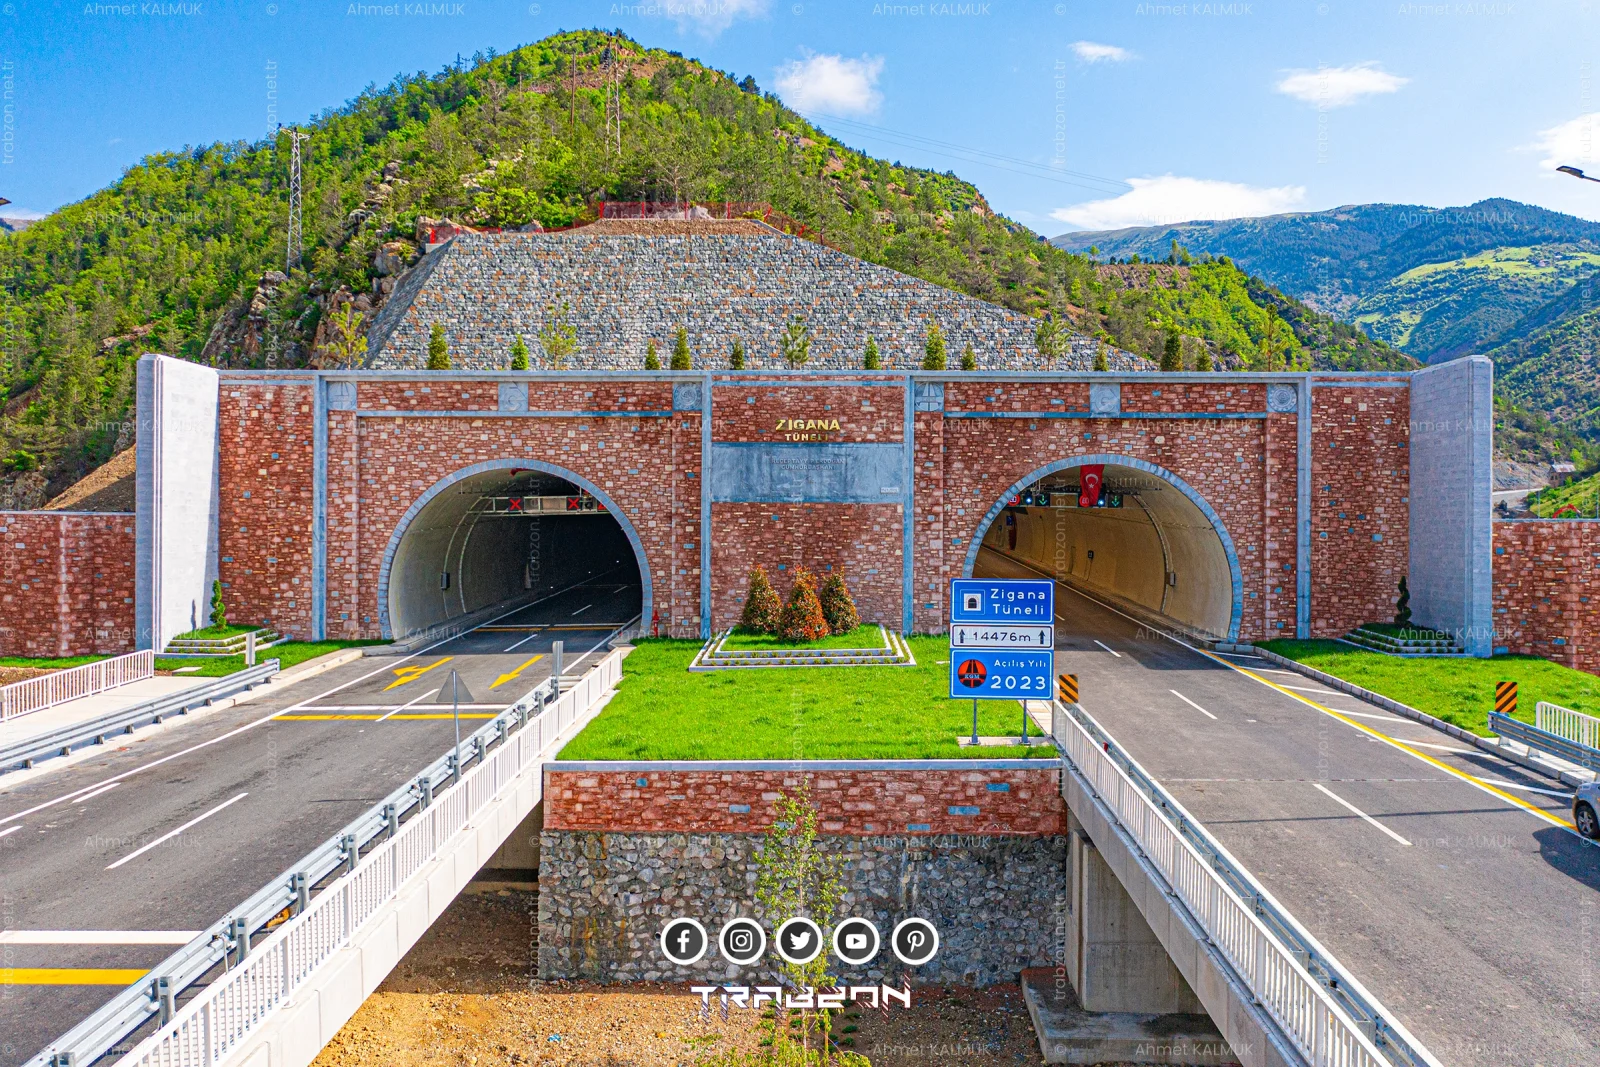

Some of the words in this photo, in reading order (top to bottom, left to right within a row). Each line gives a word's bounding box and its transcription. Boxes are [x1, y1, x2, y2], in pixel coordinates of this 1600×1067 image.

[990, 588, 1046, 602] Zigana
[992, 604, 1044, 615] Tüneli
[973, 631, 1031, 642] 14476m
[994, 660, 1025, 668] Açılış
[1028, 660, 1046, 668] Yılı
[990, 675, 1046, 690] 2023
